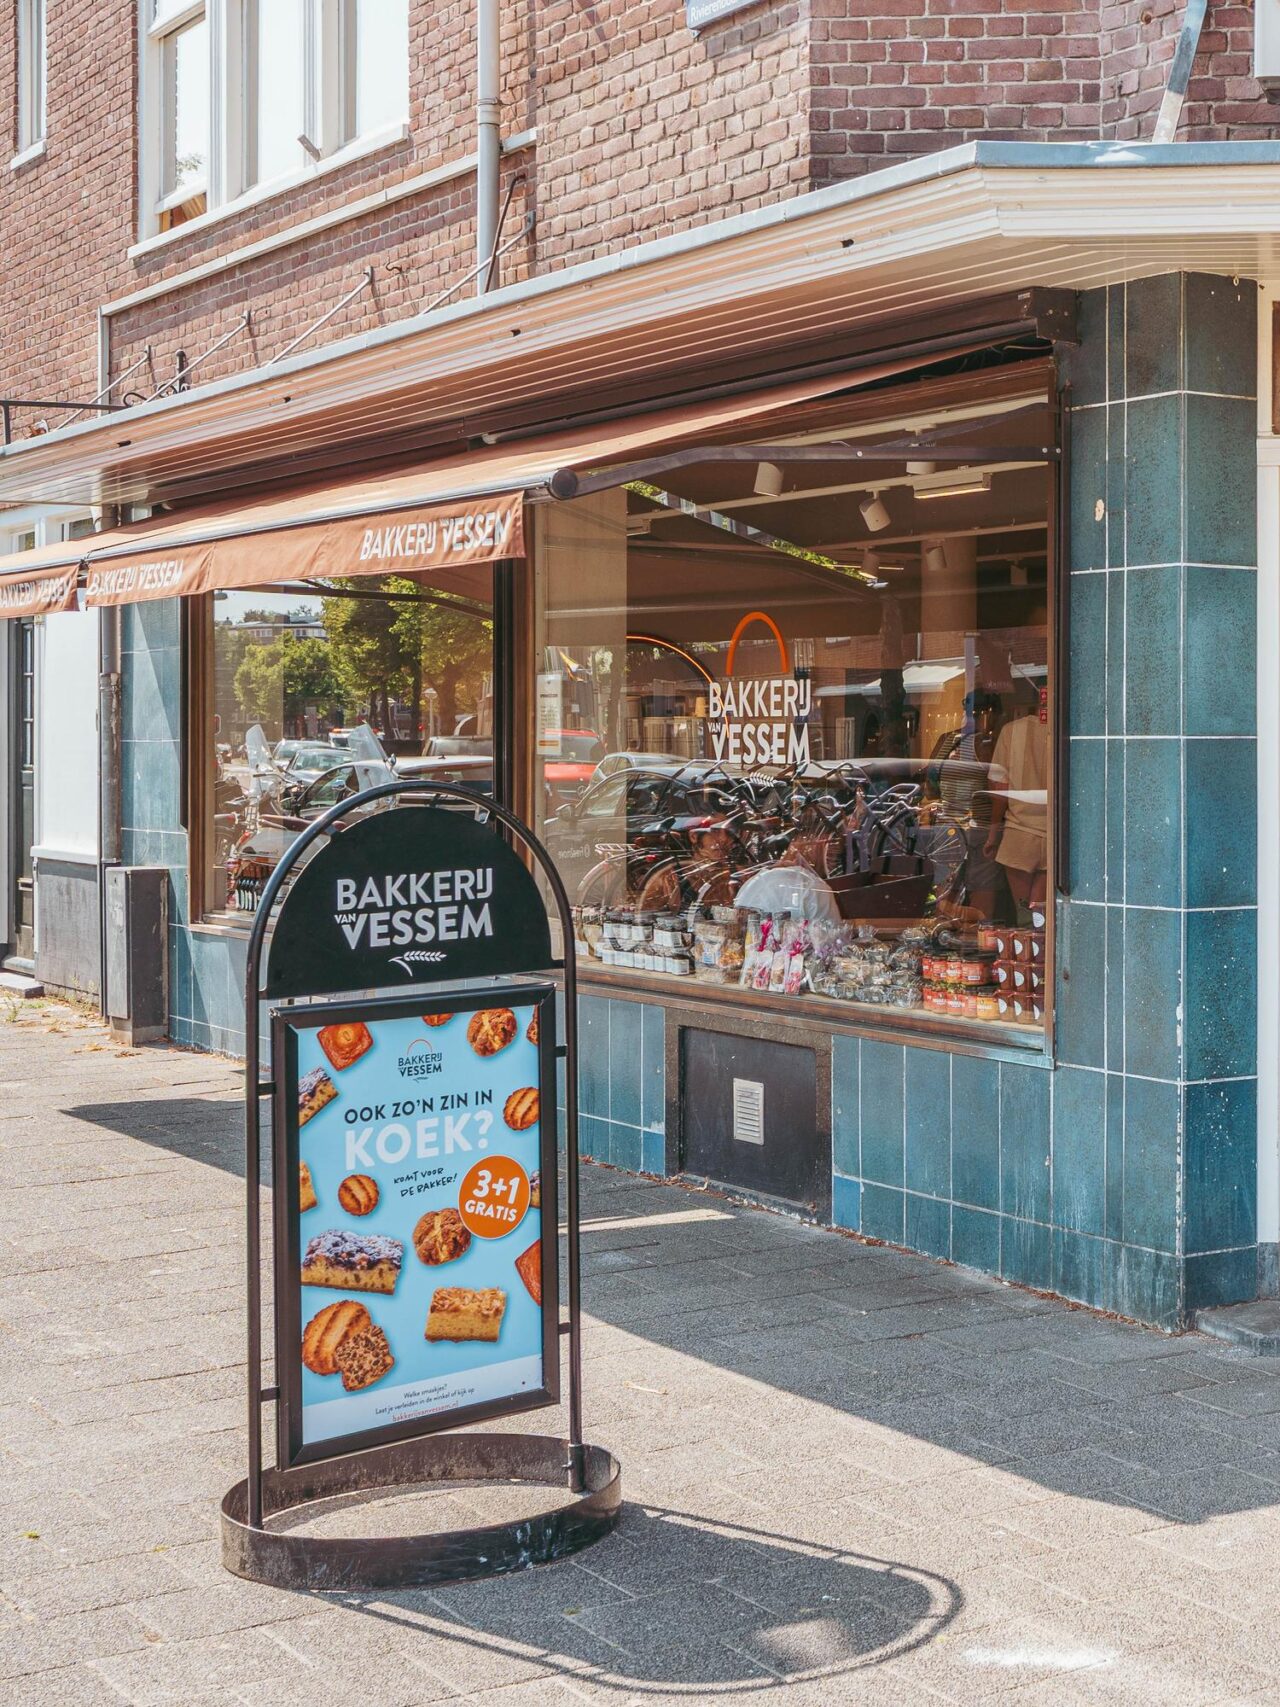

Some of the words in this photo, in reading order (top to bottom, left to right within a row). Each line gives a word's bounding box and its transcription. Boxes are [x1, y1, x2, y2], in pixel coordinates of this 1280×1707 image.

[360, 521, 437, 560] BAKKERIJ
[139, 559, 184, 590] VESSEM
[0, 581, 35, 608] AKKERIJ
[709, 679, 811, 718] BAKKERIJ
[707, 722, 721, 733] VAN
[712, 723, 811, 764] VESSEM
[336, 868, 493, 911] BAKKERIJ
[334, 913, 357, 925] VAN
[341, 902, 494, 950] VESSEM
[398, 1052, 443, 1067] BAKKERIJ
[400, 1063, 443, 1077] VESSEM
[344, 1104, 386, 1124] OOK
[440, 1092, 468, 1111] ZIN
[475, 1089, 492, 1106] IN
[345, 1109, 494, 1170] KOEK?
[400, 1187, 414, 1197] DE
[417, 1173, 458, 1194] BAKKER!
[420, 1167, 444, 1179] VOOR
[472, 1169, 520, 1205] 3+1
[465, 1200, 518, 1223] GRATIS
